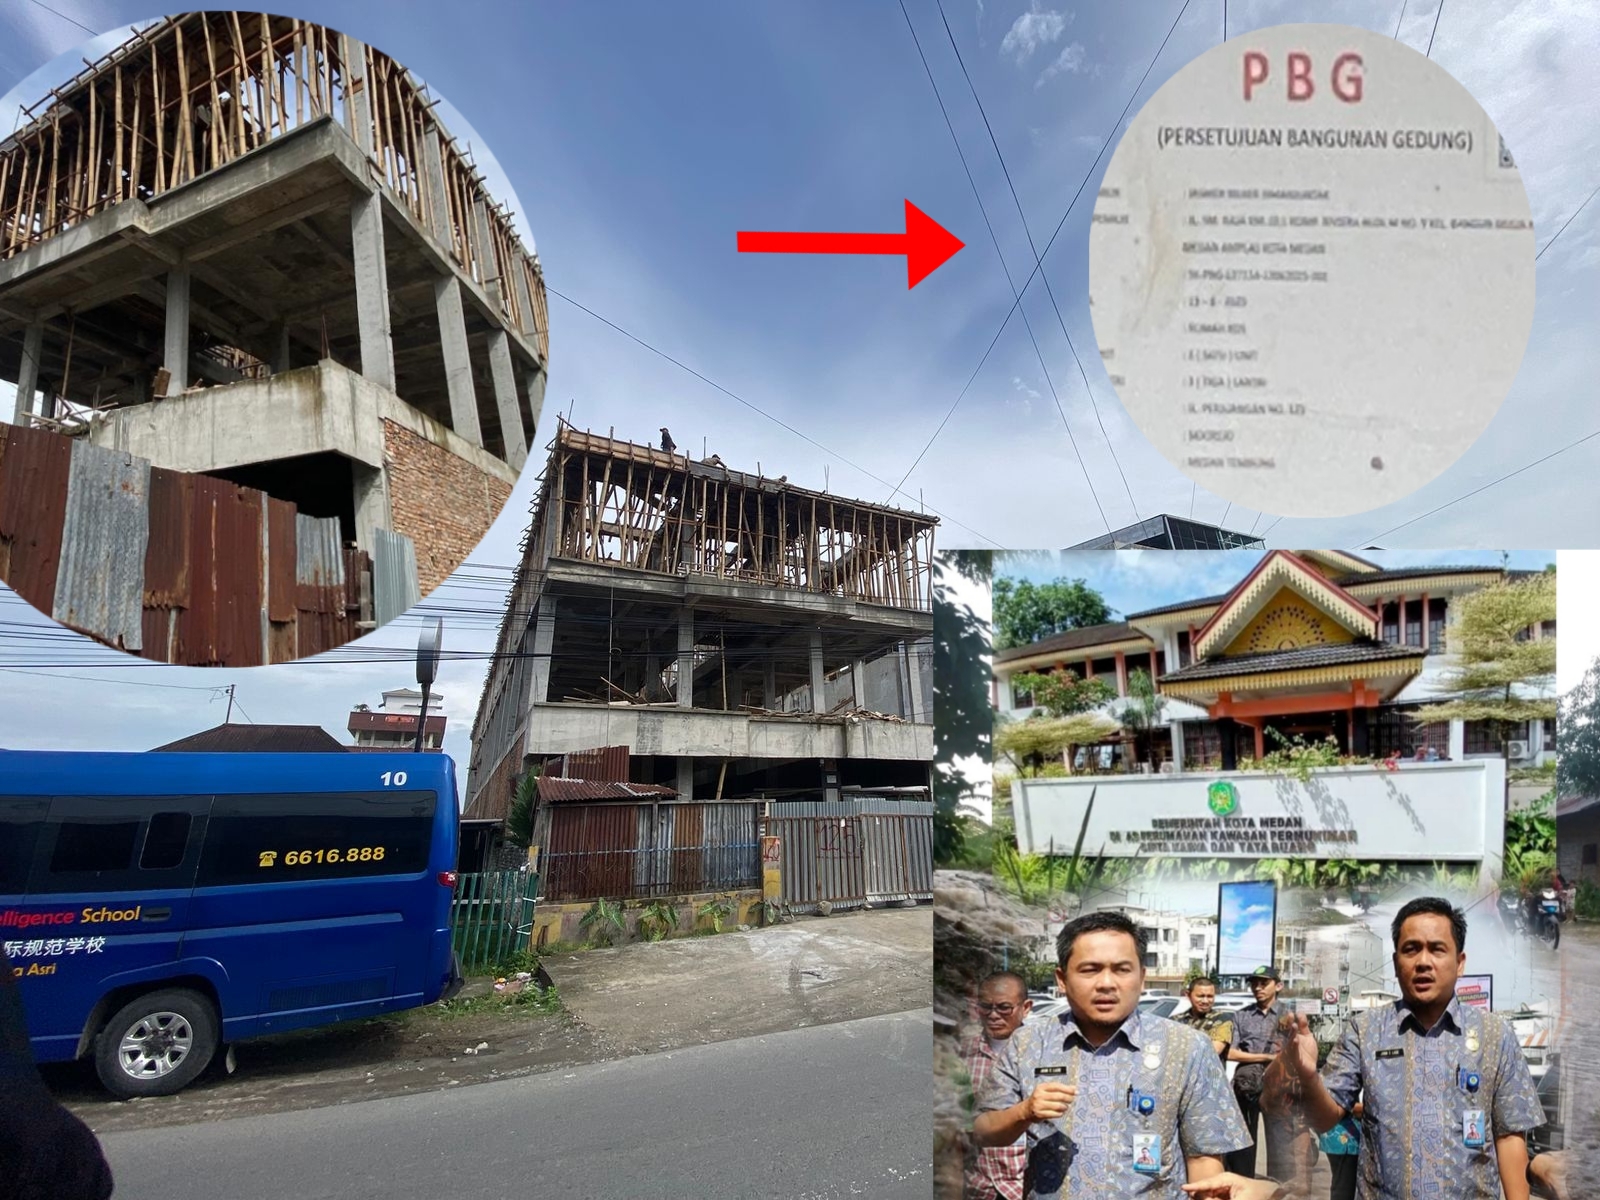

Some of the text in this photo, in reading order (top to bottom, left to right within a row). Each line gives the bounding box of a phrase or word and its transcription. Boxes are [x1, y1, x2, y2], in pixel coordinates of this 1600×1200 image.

[1157, 125, 1474, 154] (PERSETUJUAN BANGUNAN GEDUNG)
[380, 771, 408, 787] 10
[1224, 818, 1256, 829] KOTA
[1260, 817, 1303, 829] MEDAN
[1210, 830, 1268, 842] KAWASAN
[1210, 841, 1235, 853] DAN
[1238, 841, 1270, 853] TATA
[284, 846, 386, 866] 6616.888
[80, 905, 141, 924] School
[26, 962, 57, 976] Asri
